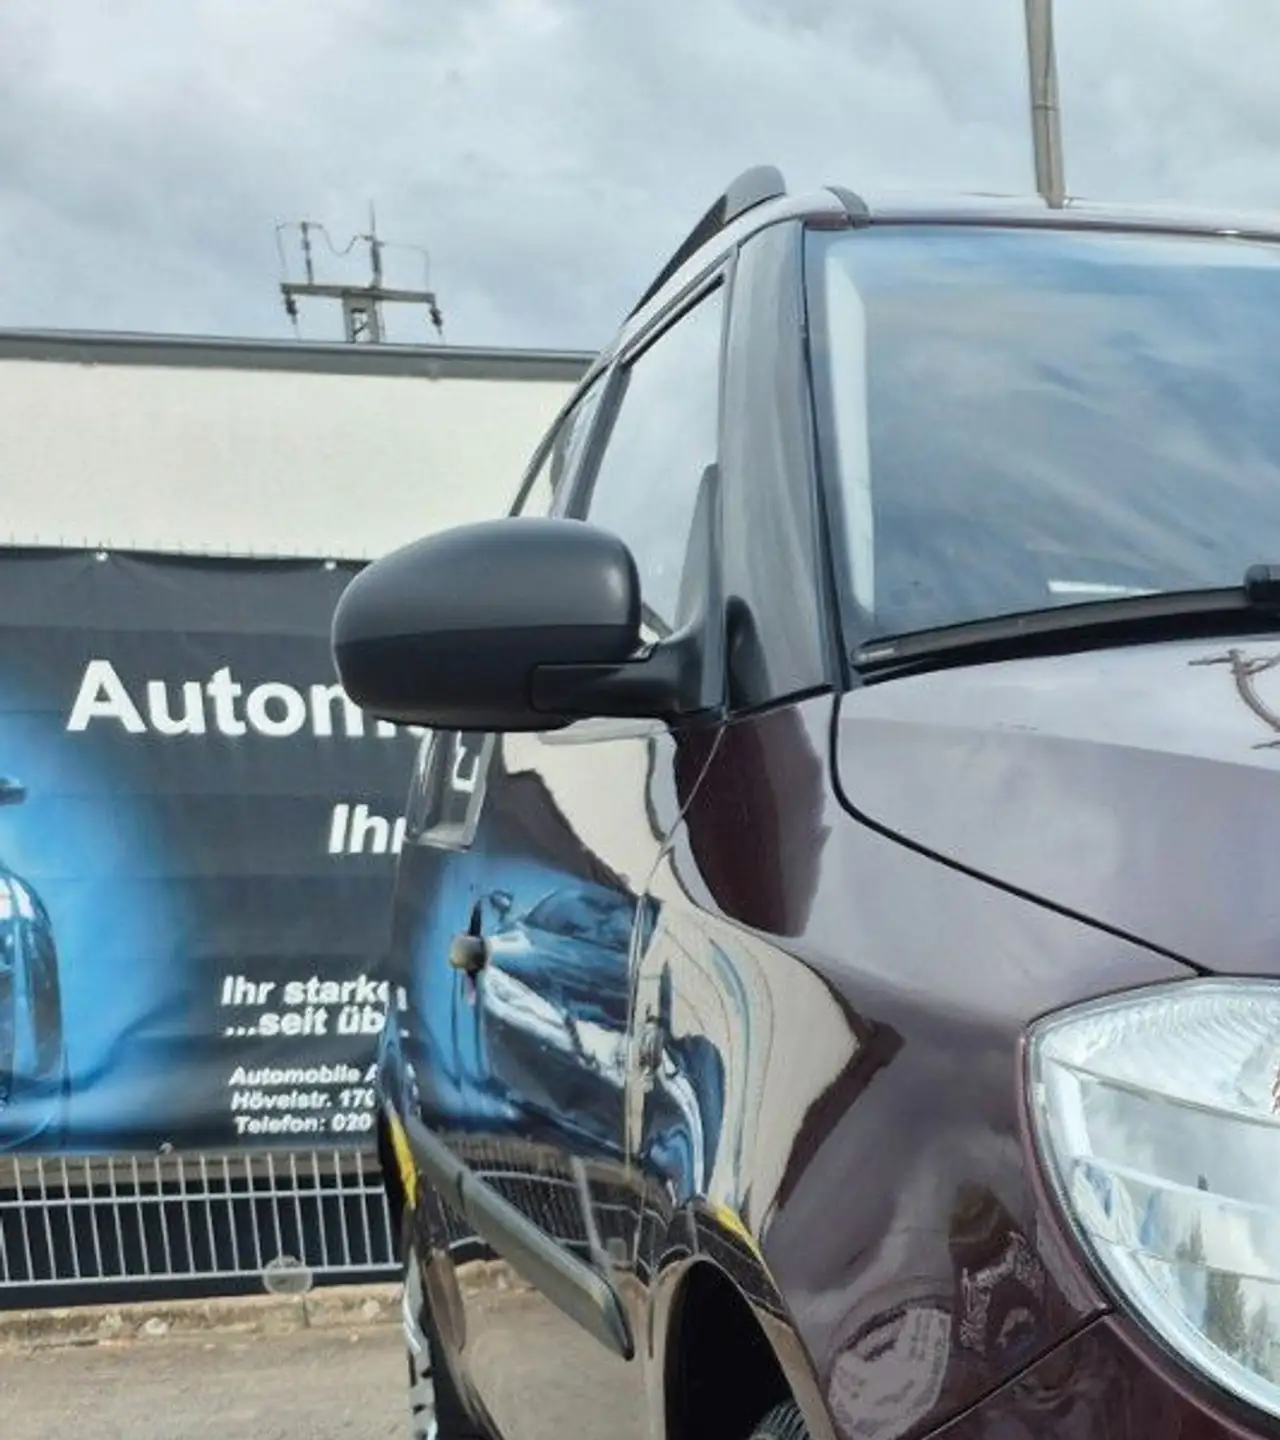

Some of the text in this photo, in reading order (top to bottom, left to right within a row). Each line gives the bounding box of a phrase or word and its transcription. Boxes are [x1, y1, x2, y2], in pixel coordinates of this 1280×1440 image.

[66, 659, 428, 737] Autom
[220, 975, 276, 1006] Ihr
[228, 1064, 360, 1086] Automobile
[235, 1113, 325, 1134] Telefon:
